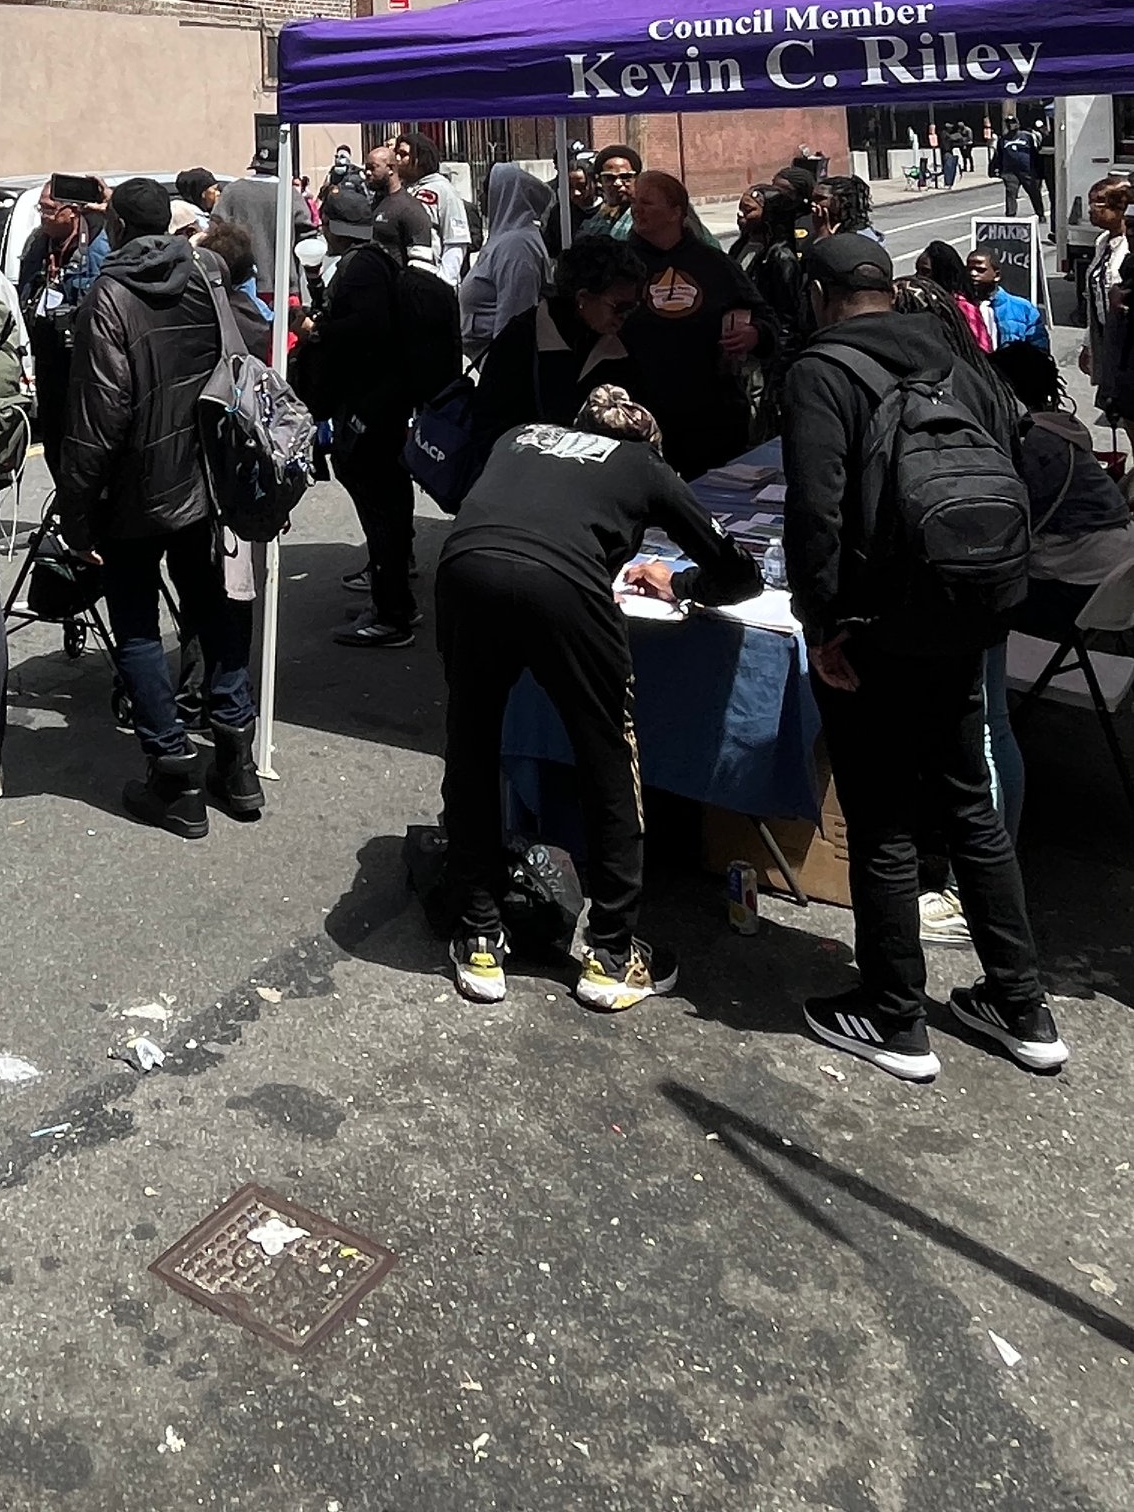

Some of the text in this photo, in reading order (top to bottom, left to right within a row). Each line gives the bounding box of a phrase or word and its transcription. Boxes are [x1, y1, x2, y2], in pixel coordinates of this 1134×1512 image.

[648, 1, 935, 42] Council Member
[566, 31, 1043, 99] Kevin C. Riley
